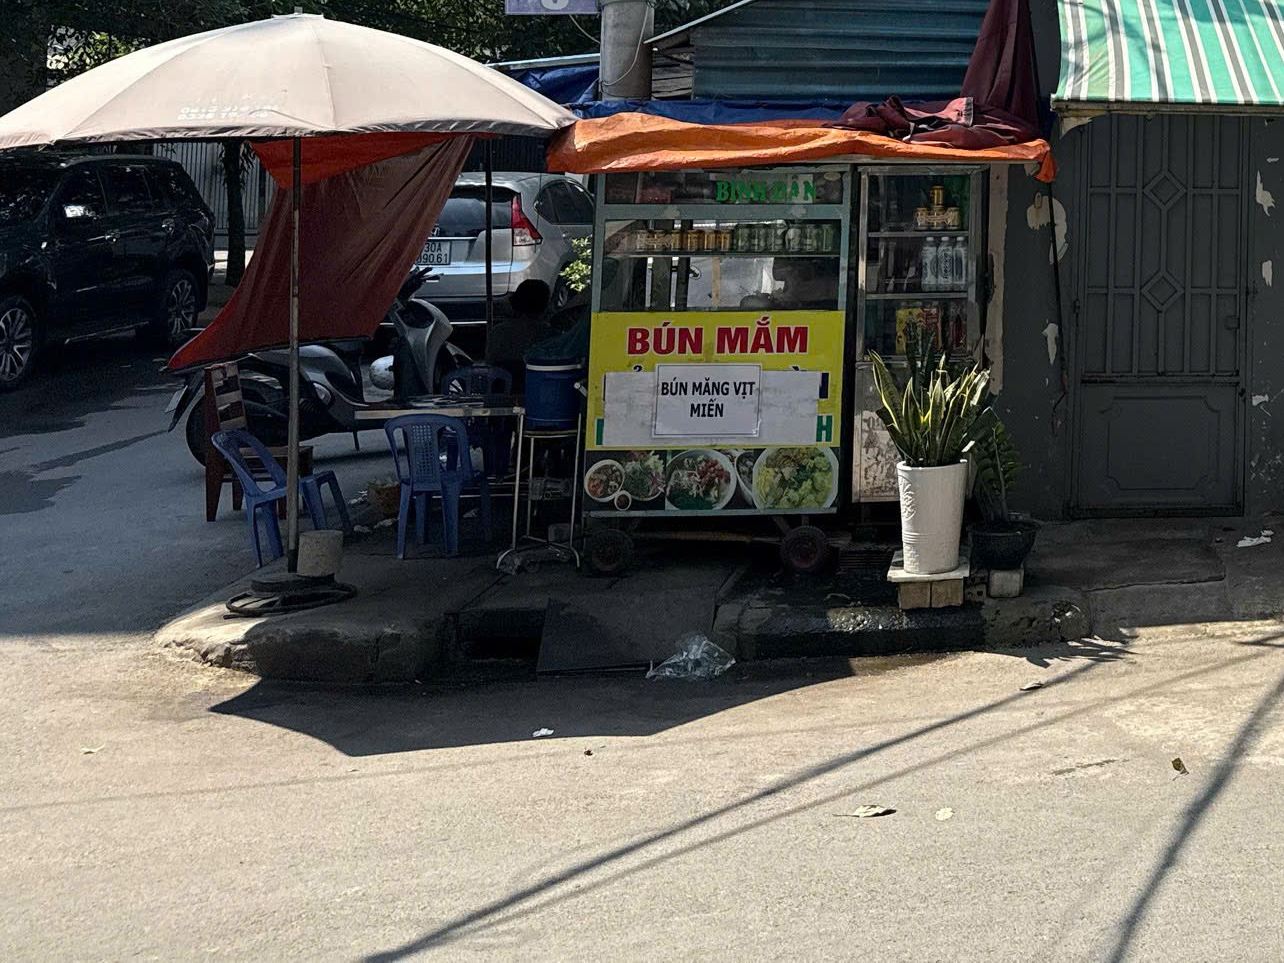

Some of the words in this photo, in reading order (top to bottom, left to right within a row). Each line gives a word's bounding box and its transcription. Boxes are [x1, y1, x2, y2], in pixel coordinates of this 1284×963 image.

[424, 242, 442, 253] 30A
[626, 321, 704, 355] BÚN
[715, 316, 809, 354] MẮM
[660, 376, 688, 396] BÚN
[692, 377, 729, 396] MĂNG
[733, 381, 756, 399] VỊT
[689, 398, 724, 418] MIẾN
